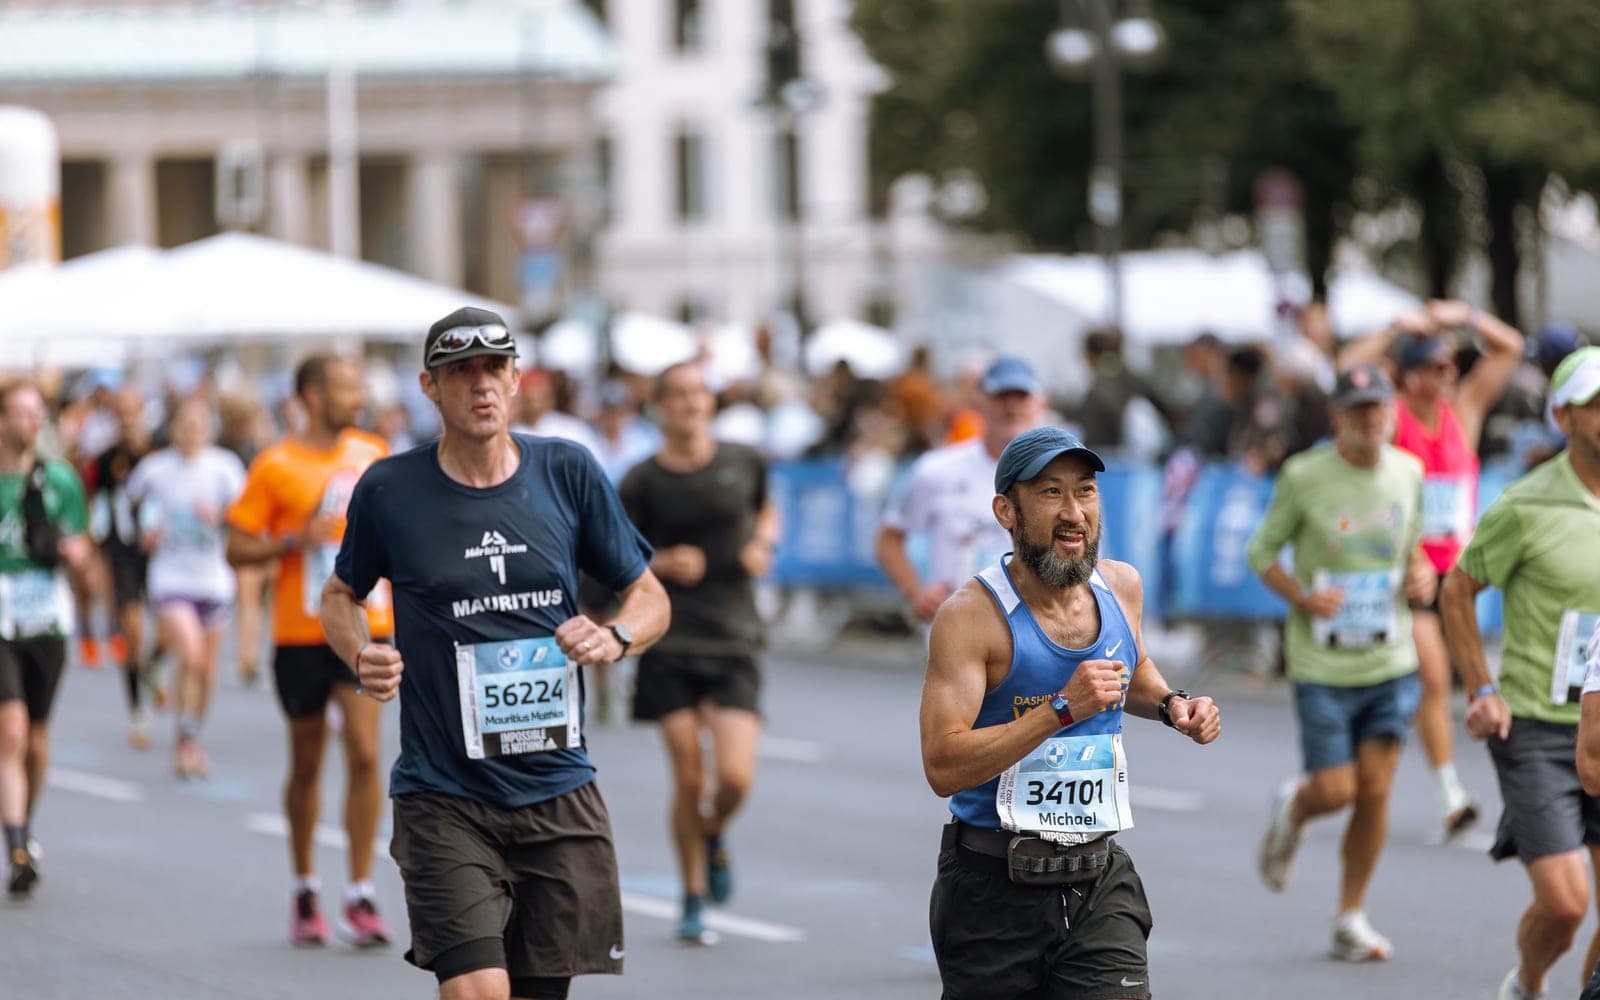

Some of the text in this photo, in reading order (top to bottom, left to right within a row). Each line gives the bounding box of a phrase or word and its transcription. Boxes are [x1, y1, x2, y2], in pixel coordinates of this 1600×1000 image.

[452, 588, 562, 618] MAURITIUS
[485, 679, 563, 708] 56224
[1013, 693, 1057, 706] DASHIN
[1118, 772, 1125, 782] E
[1026, 779, 1104, 806] 34101
[1039, 812, 1097, 826] Michael
[1040, 831, 1089, 844] IMPOSSIBLE
